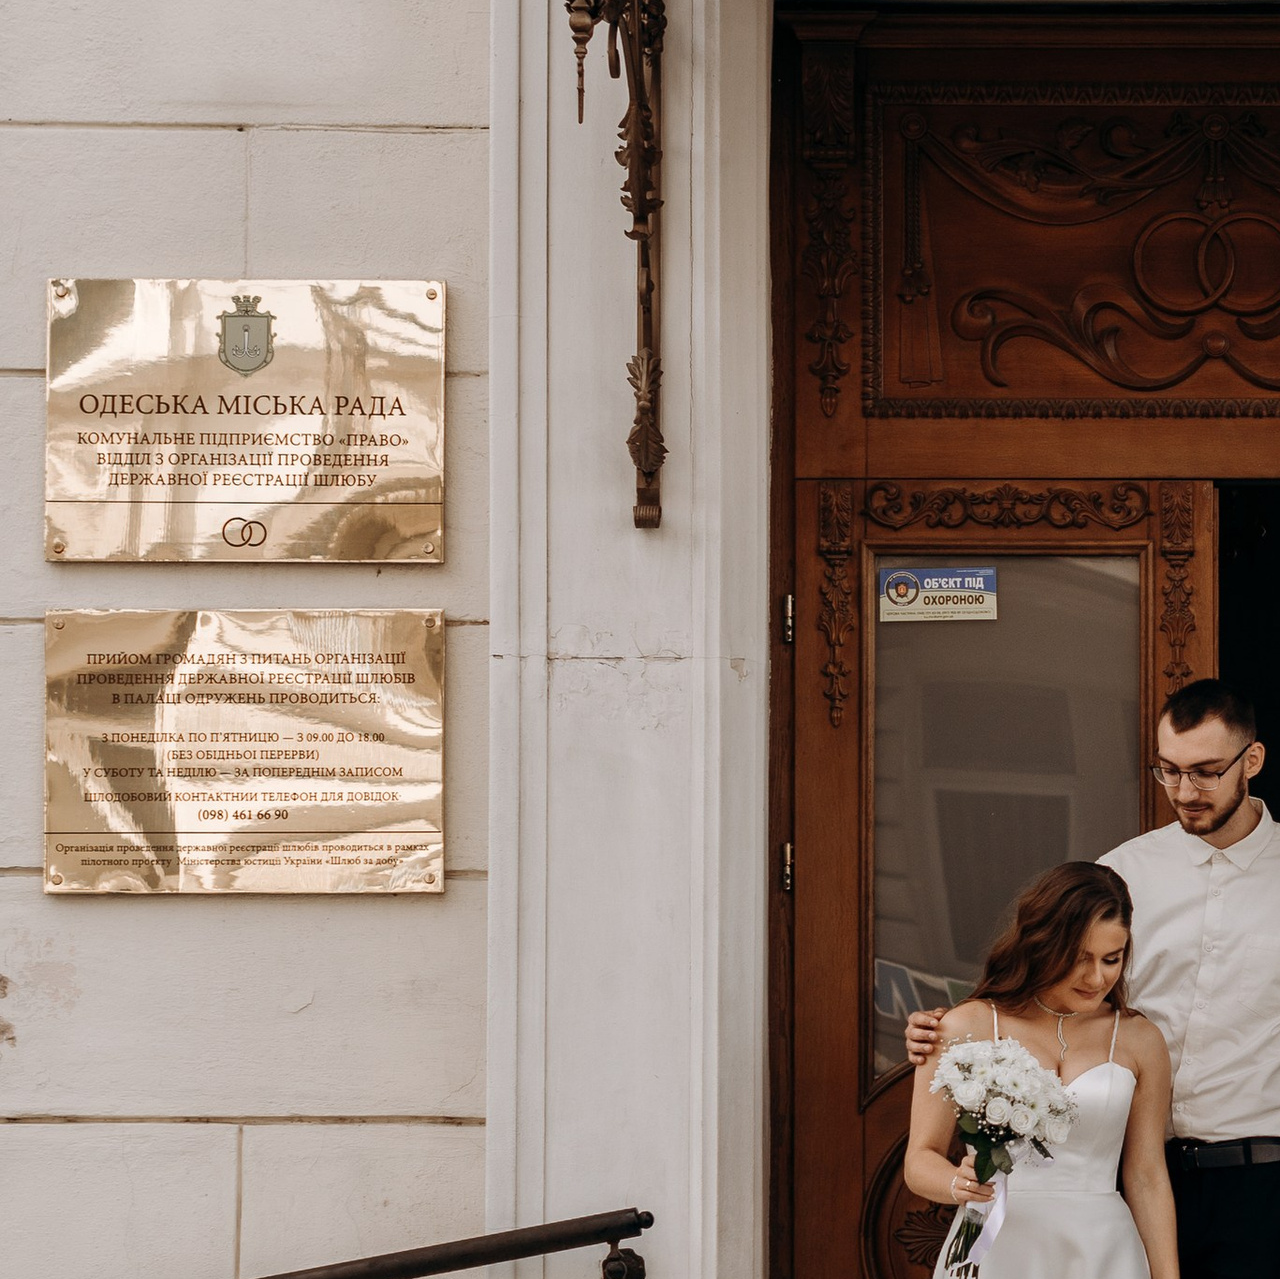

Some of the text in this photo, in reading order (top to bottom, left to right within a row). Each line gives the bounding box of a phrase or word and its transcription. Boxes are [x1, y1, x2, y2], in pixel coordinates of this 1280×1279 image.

[79, 393, 407, 420] ОДЕСЬКА МІСЬКА РАДА
[77, 432, 409, 447] КОМУНАЛЬНЕ ПІДПРИЄМСТВО «ПРАВО»
[96, 452, 151, 467] ВІДДІЛ
[168, 451, 274, 468] ОРГАНІЗАЦІЇ
[277, 453, 389, 469] ПРОВЕДЕННЯ
[108, 471, 378, 488] ДЕРЖАВНОЇ РЕЄСТРАЦІЇ ШЛЮБУ
[964, 577, 985, 590] ПІД
[923, 594, 985, 606] ОХОРОНОЮ
[86, 652, 152, 665] ПРИЙОМ
[155, 653, 237, 666] ГРОМАДЯН
[251, 653, 312, 665] ПИТАНЬ
[314, 652, 407, 665] ОРГАНІЗАЦІЇ
[76, 671, 416, 686] ПРОВЕДЕННЯ ДЕРЖАВНОЇ РЕЄСТРАЦІЇ ШЛЮБІВ
[111, 692, 381, 706] В ПАЛАЦІ ОДРУЖЕНЬ ПРОВОДИТЬСЯ:
[111, 732, 185, 744] ПОНЕДІЛКА
[188, 732, 207, 743] ПО
[306, 733, 334, 743] 09.00
[336, 733, 355, 744] ДО
[358, 733, 385, 743] 18.00
[166, 749, 193, 762] (БЕЗ
[260, 749, 320, 762] ПЕРЕРВИ)
[83, 768, 91, 778] У
[93, 767, 145, 778] СУБОТУ
[147, 768, 164, 778] ТА
[166, 768, 217, 779] НЕДІЛЮ
[234, 768, 250, 778] ЗА
[252, 767, 336, 778] ПОПЕРЕДНІМ
[339, 767, 404, 777] ЗАПИСОМ
[84, 790, 172, 804] ЦІЛОДОБОВИЙ
[261, 792, 318, 802] ТЕЛЕФОН
[320, 792, 344, 803] ДЛЯ
[197, 809, 289, 822] (098) 461 66 90
[55, 843, 114, 854] Організація
[117, 844, 174, 854] проведення
[282, 842, 320, 852] шлюбів
[322, 843, 384, 853] проводиться
[394, 843, 429, 853] рамках
[81, 857, 130, 866] пілотного
[176, 856, 241, 868] Міністерства
[283, 856, 322, 867] України
